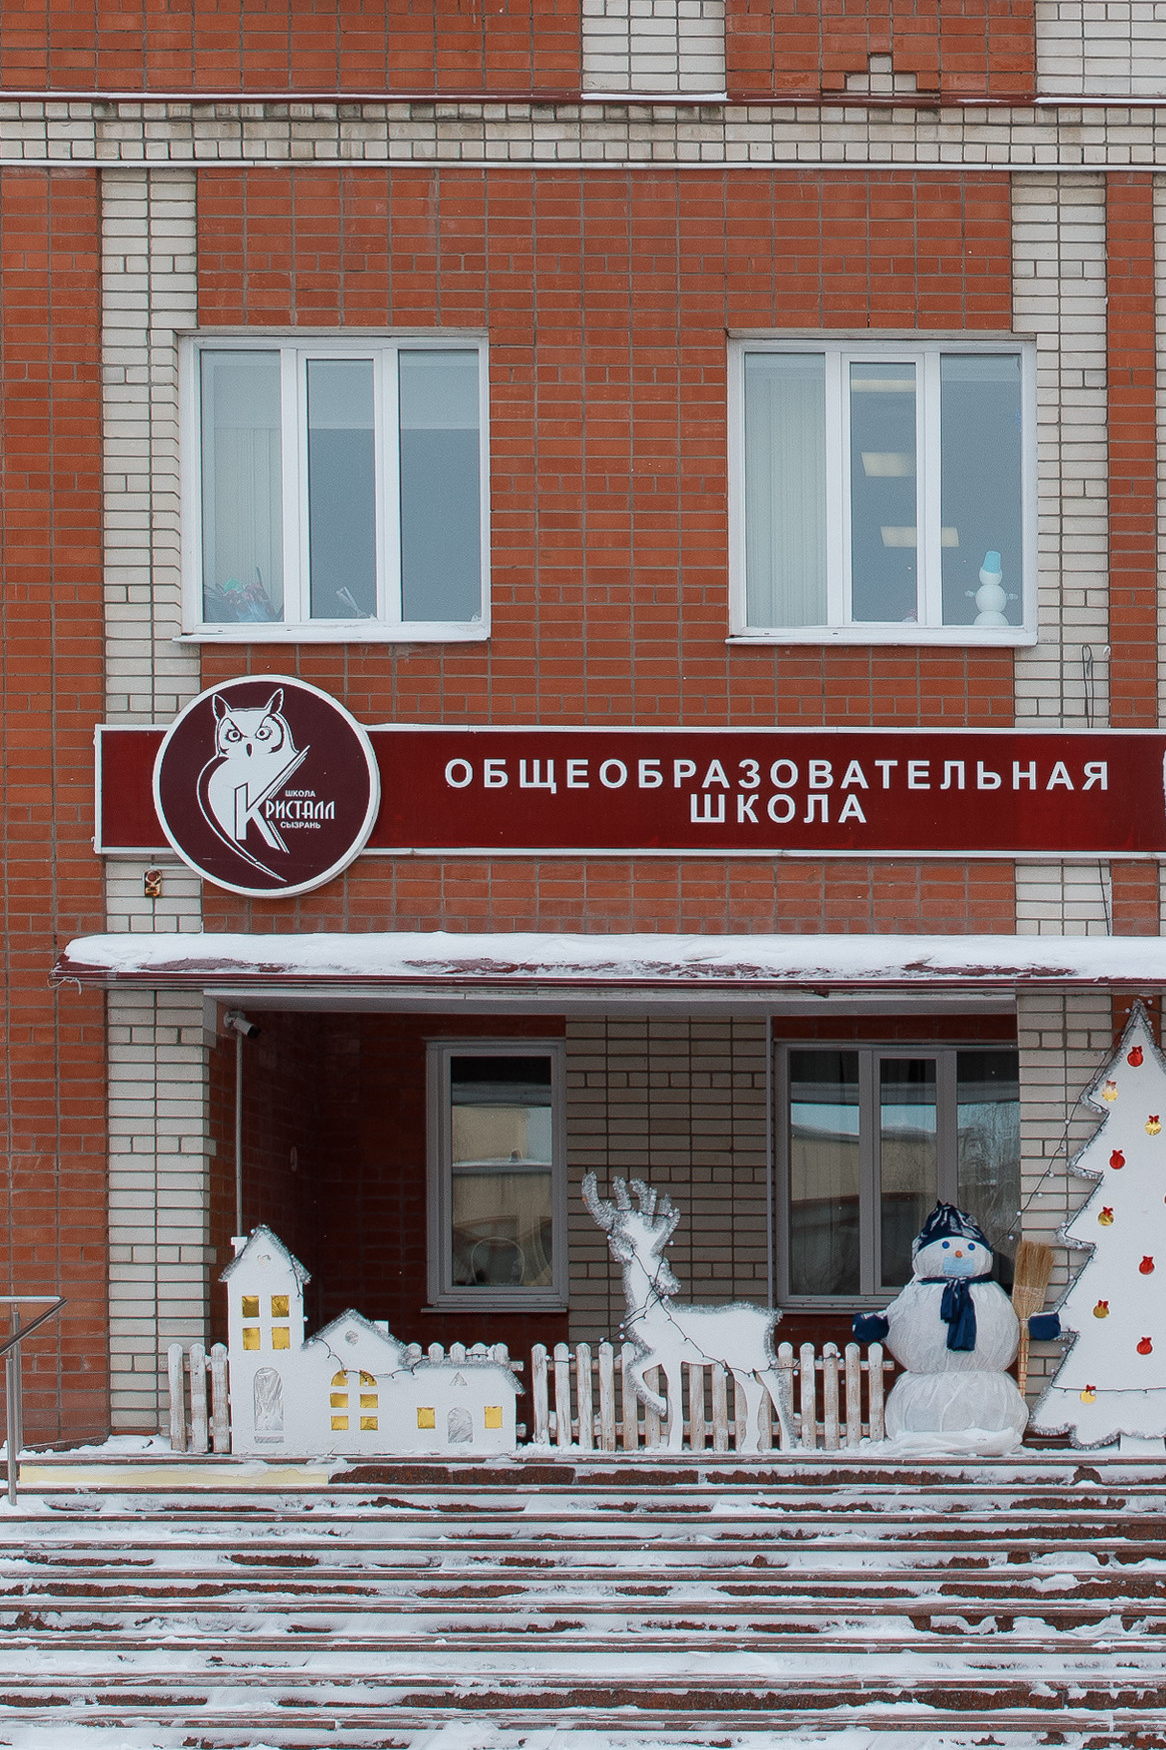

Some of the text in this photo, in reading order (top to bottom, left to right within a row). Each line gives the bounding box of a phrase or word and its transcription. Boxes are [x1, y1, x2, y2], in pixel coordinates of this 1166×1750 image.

[444, 758, 1108, 795] ОБЩЕОБРАЗОВАТЕЛЬНАЯ
[284, 789, 317, 798] ШКОЛА
[690, 793, 867, 824] ШКОЛА
[279, 820, 322, 829] СЫЗРАНЬ
